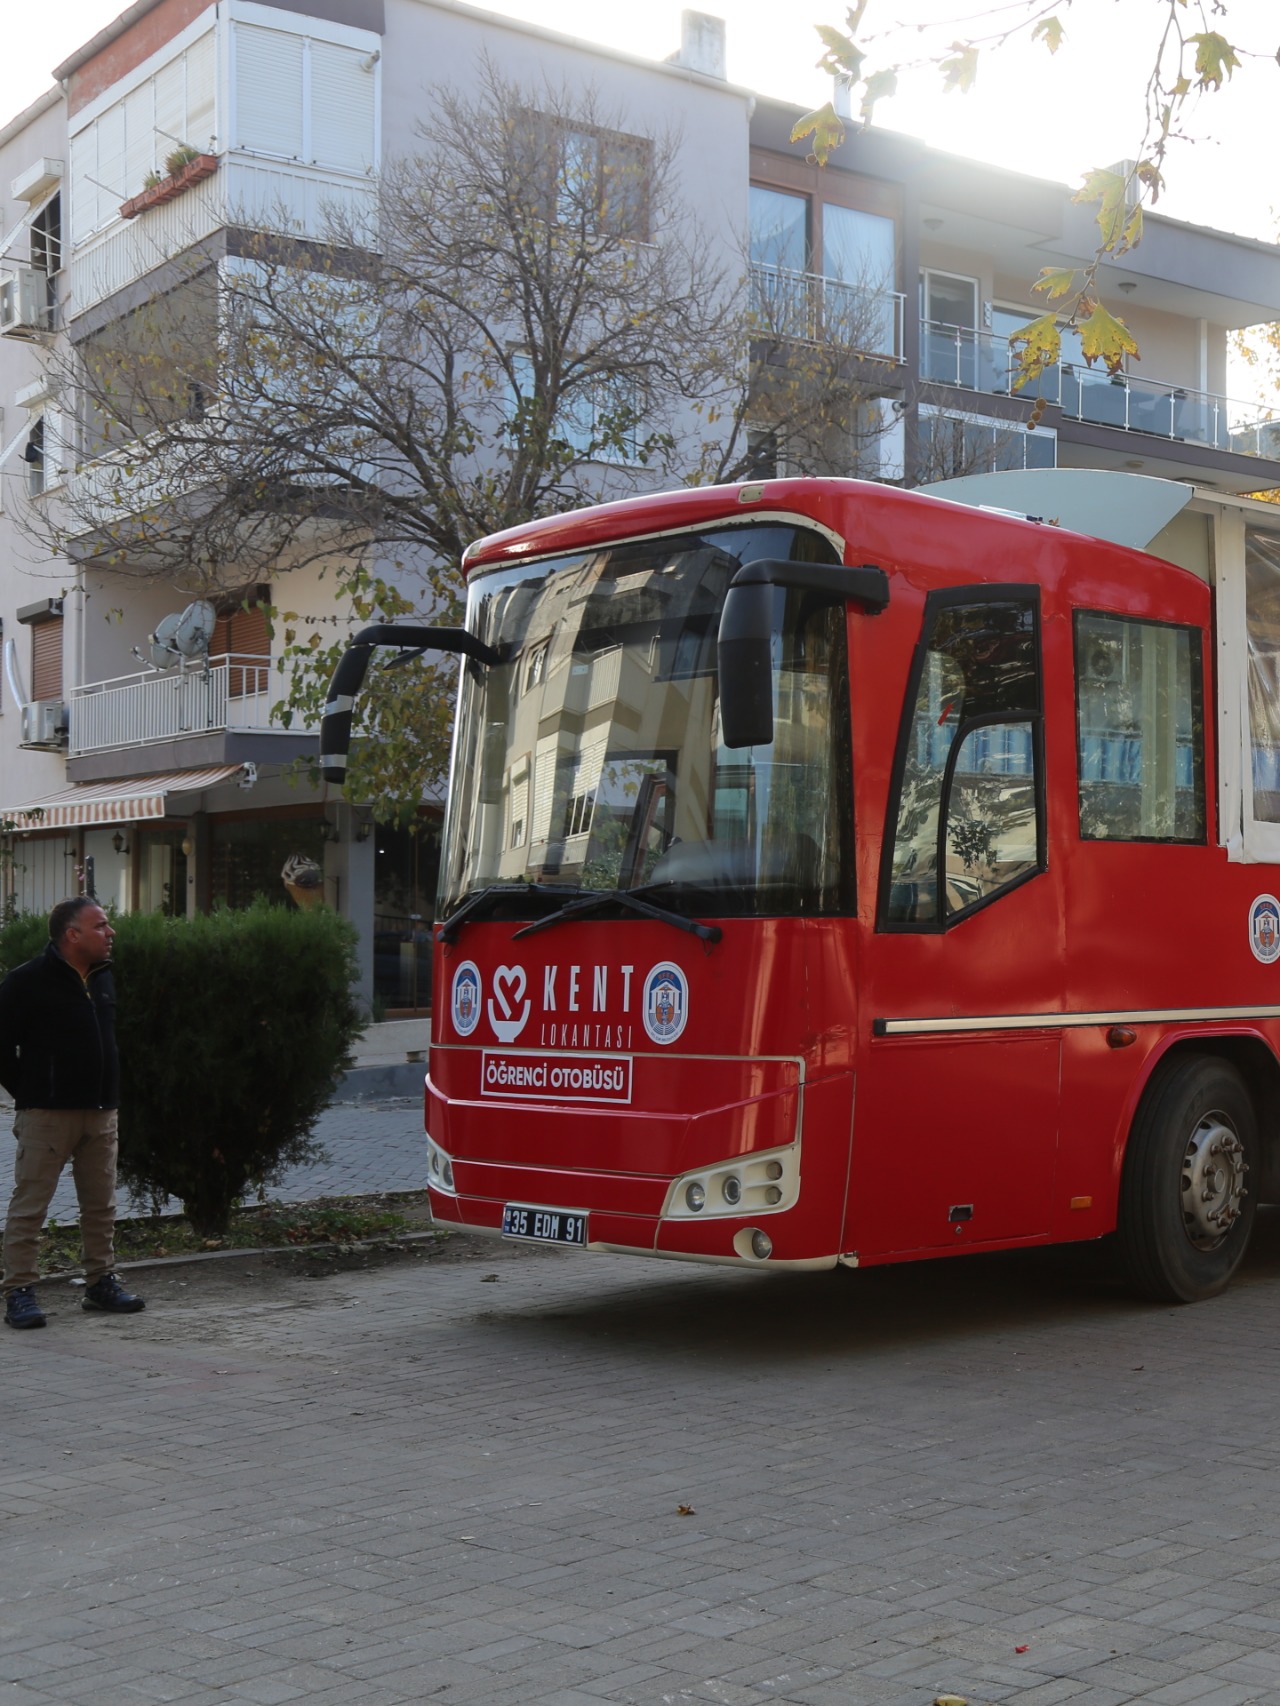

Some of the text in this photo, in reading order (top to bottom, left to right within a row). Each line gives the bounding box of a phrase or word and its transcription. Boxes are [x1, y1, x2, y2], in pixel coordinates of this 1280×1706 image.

[543, 965, 634, 1013] KENT
[541, 1023, 632, 1048] LOKANTASI
[487, 1060, 624, 1091] ÖĞRENCİ OTOBÜSÜ
[511, 1210, 583, 1242] 35 EDM 91
